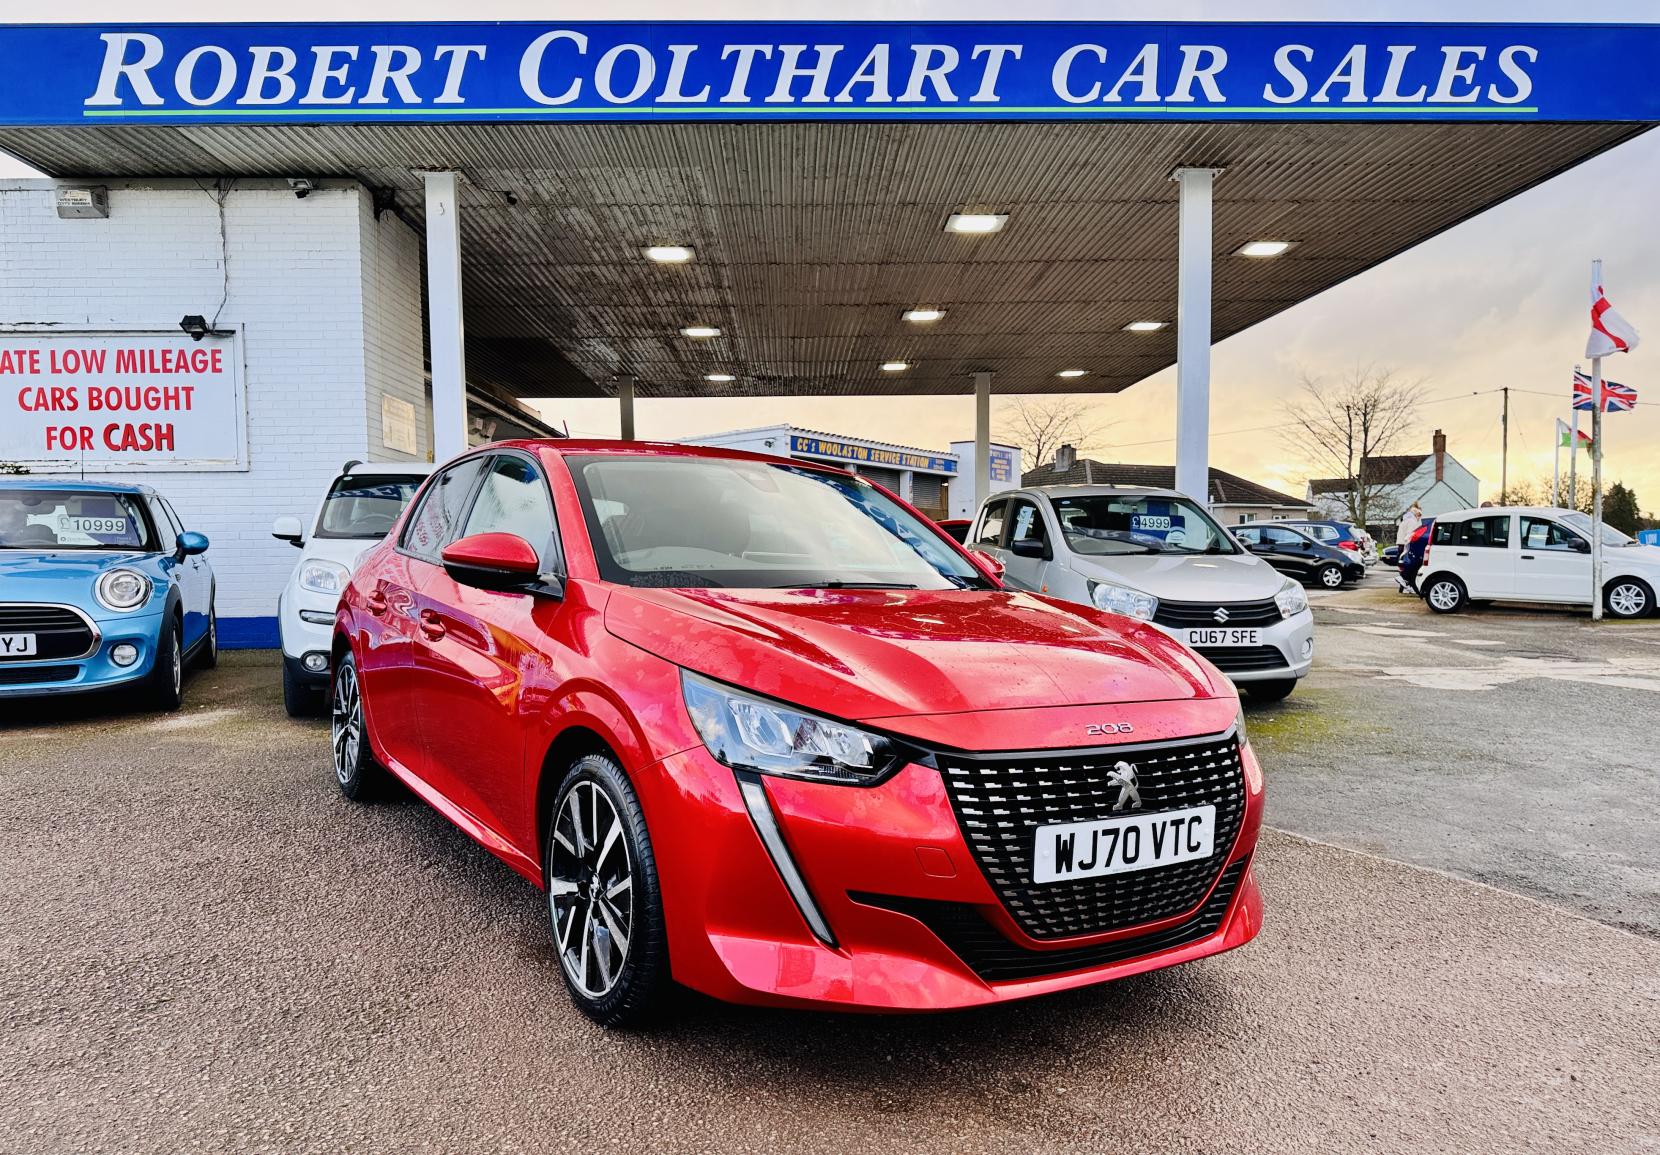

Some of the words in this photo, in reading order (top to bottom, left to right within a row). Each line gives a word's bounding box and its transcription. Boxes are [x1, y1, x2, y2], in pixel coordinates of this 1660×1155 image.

[85, 33, 486, 106] ROBERT
[518, 29, 1022, 106] COLTHART
[1052, 43, 1228, 104] CAR
[1263, 44, 1539, 104] SALES
[0, 349, 41, 374] ATE
[50, 349, 107, 374] LOW
[115, 349, 223, 374] MILEAGE
[18, 386, 79, 411] CARS
[88, 386, 195, 411] BOUGHT
[46, 426, 95, 451] FOR
[103, 423, 175, 452] CASH
[818, 440, 867, 461] WOOLASTON
[870, 449, 900, 464] SERVICE
[902, 453, 929, 469] STATION
[1189, 629, 1226, 644] CU67
[1232, 629, 1258, 644] SFE
[1086, 722, 1134, 736] 208
[1055, 825, 1141, 874] WJ70
[1151, 815, 1203, 860] VTC
